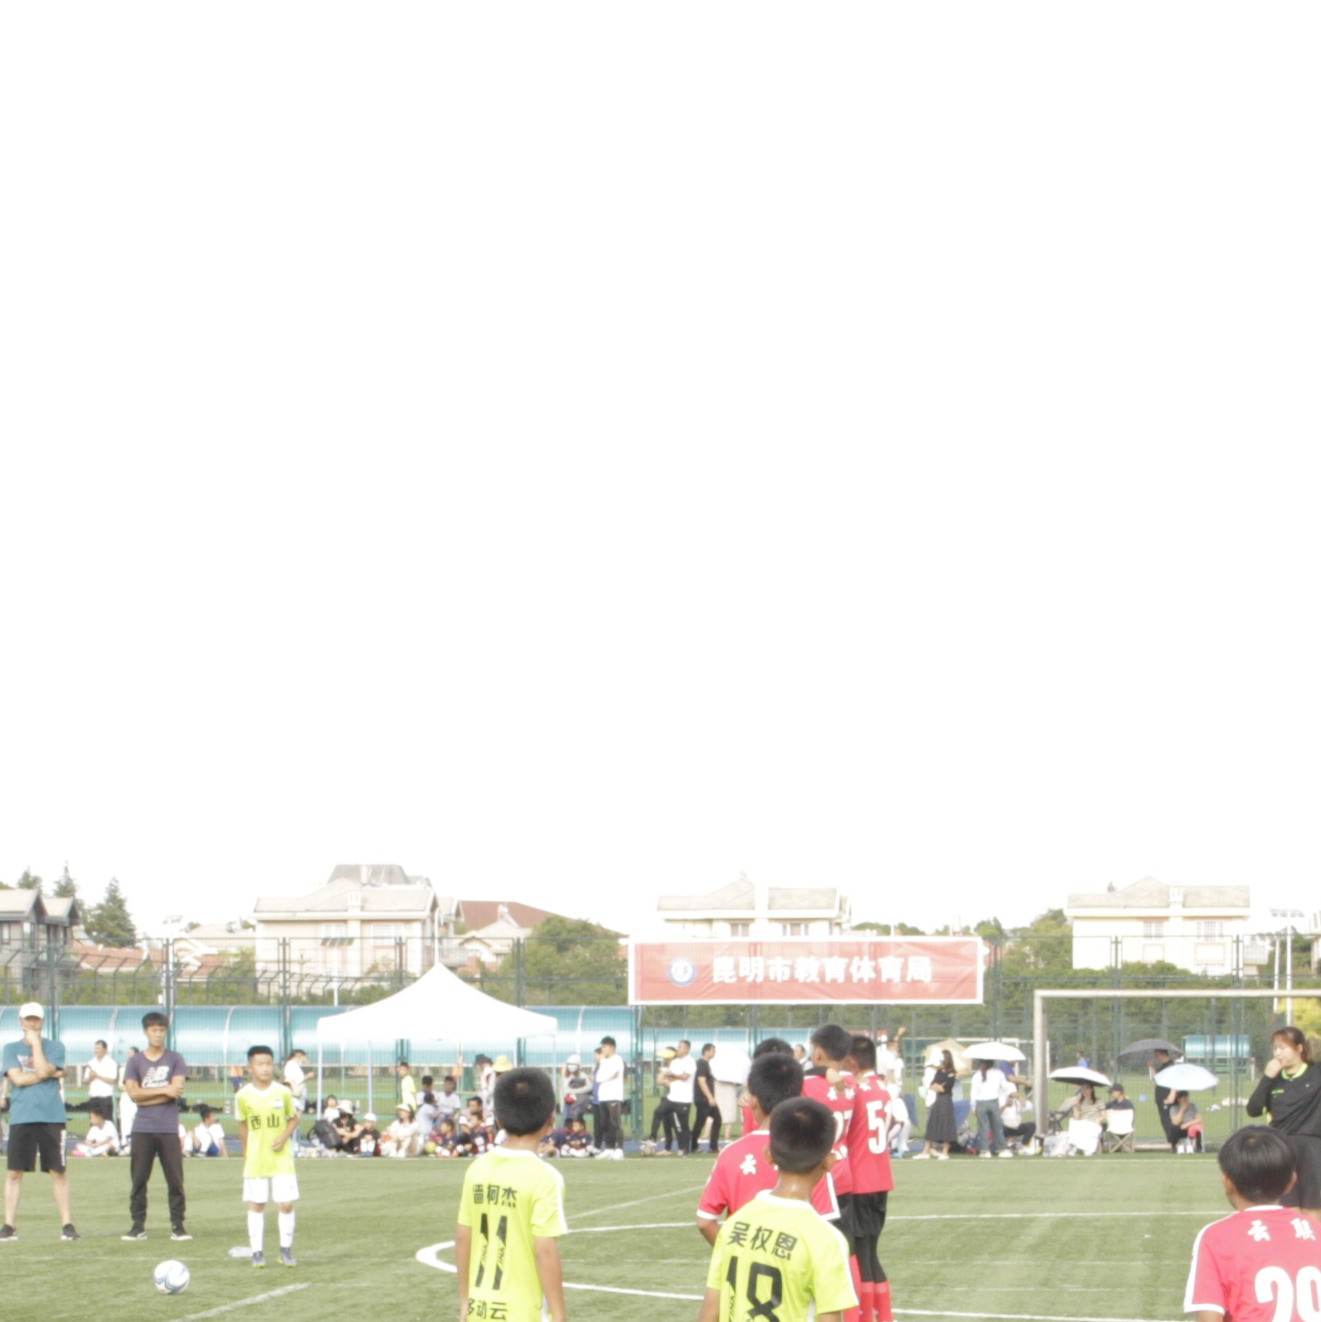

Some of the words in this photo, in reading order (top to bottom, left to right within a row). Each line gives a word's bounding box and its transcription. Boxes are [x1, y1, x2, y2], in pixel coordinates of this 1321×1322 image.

[712, 956, 933, 984] 昆明市教育体育局
[249, 1113, 280, 1130] 西山
[727, 1221, 798, 1261] 吴权恩
